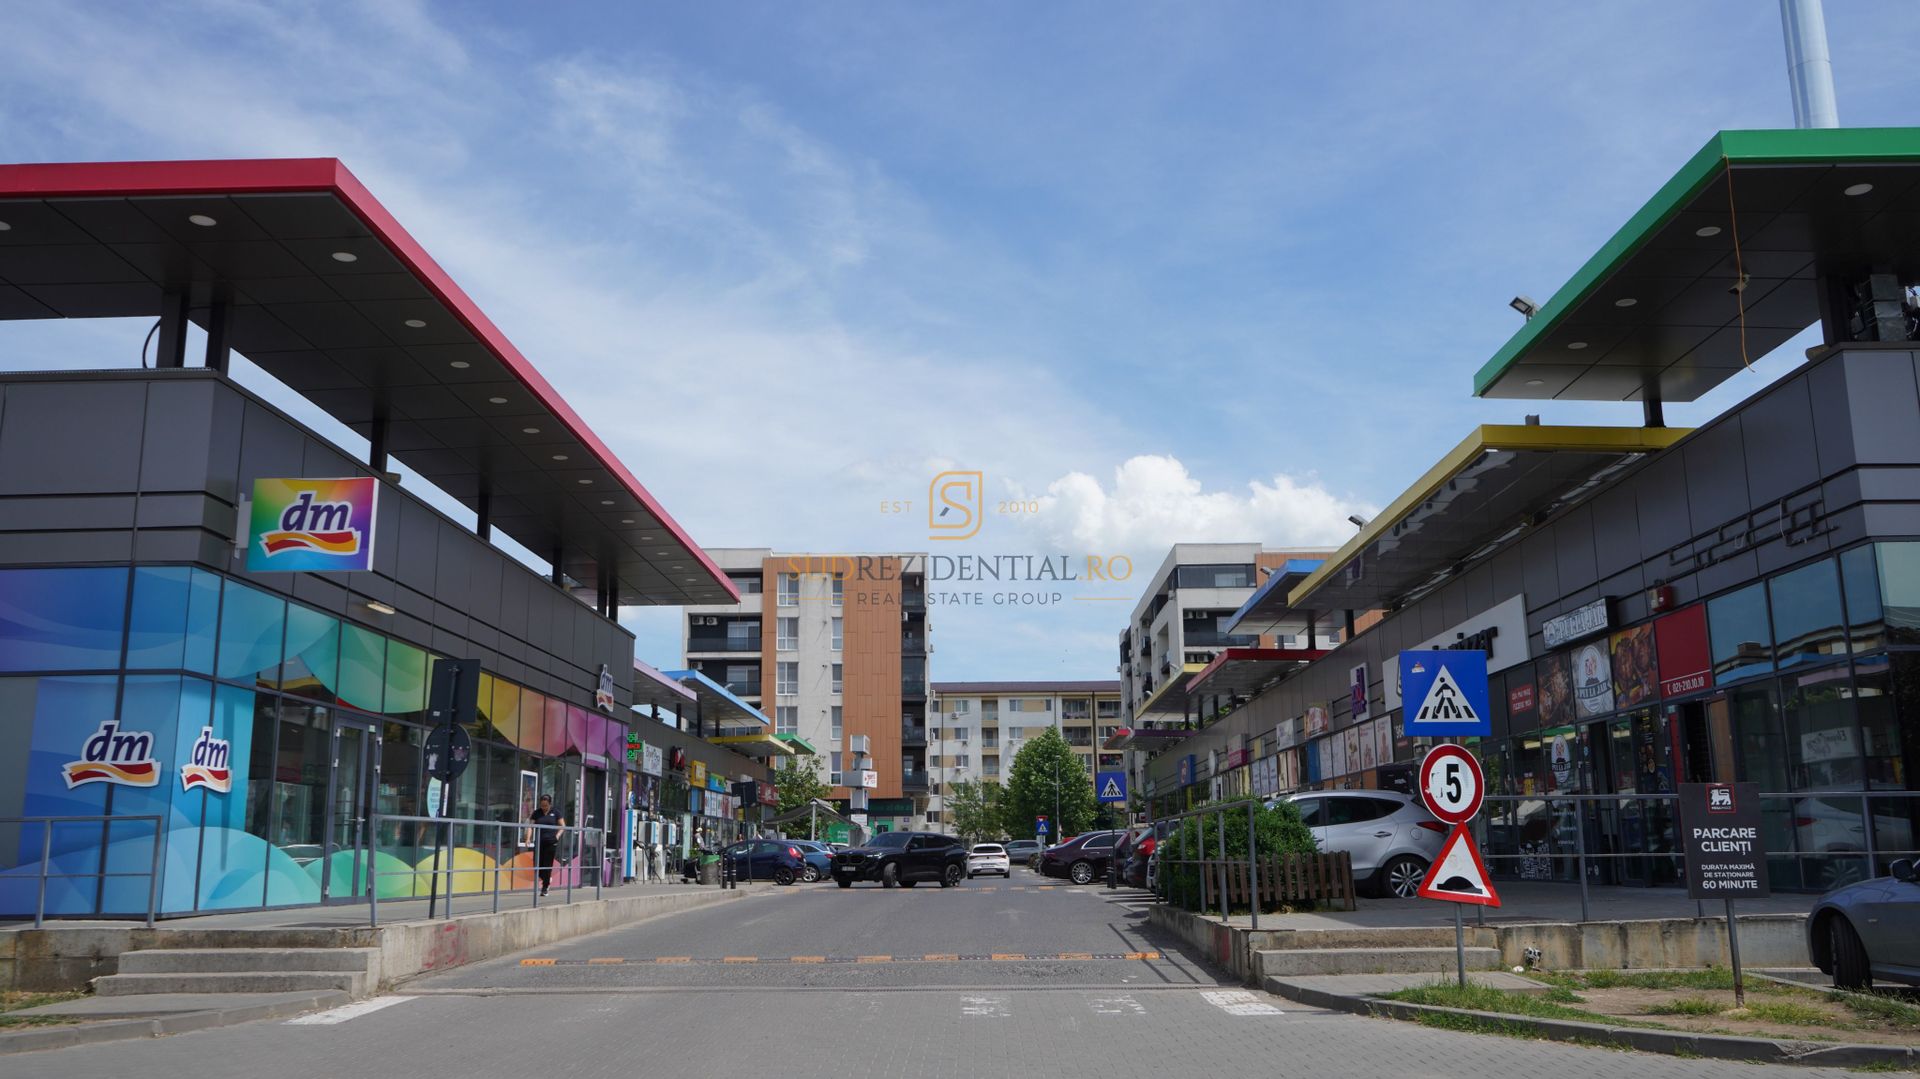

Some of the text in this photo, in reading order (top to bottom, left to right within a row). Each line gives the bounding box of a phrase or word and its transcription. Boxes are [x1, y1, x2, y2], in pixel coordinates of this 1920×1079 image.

[282, 493, 349, 533] dm
[86, 724, 150, 763] dm
[194, 731, 228, 769] dm
[1446, 764, 1461, 803] 5
[1693, 828, 1757, 839] PARCARE
[1701, 841, 1751, 855] CLIENȚI
[1702, 880, 1758, 889] 60 MINUTE
